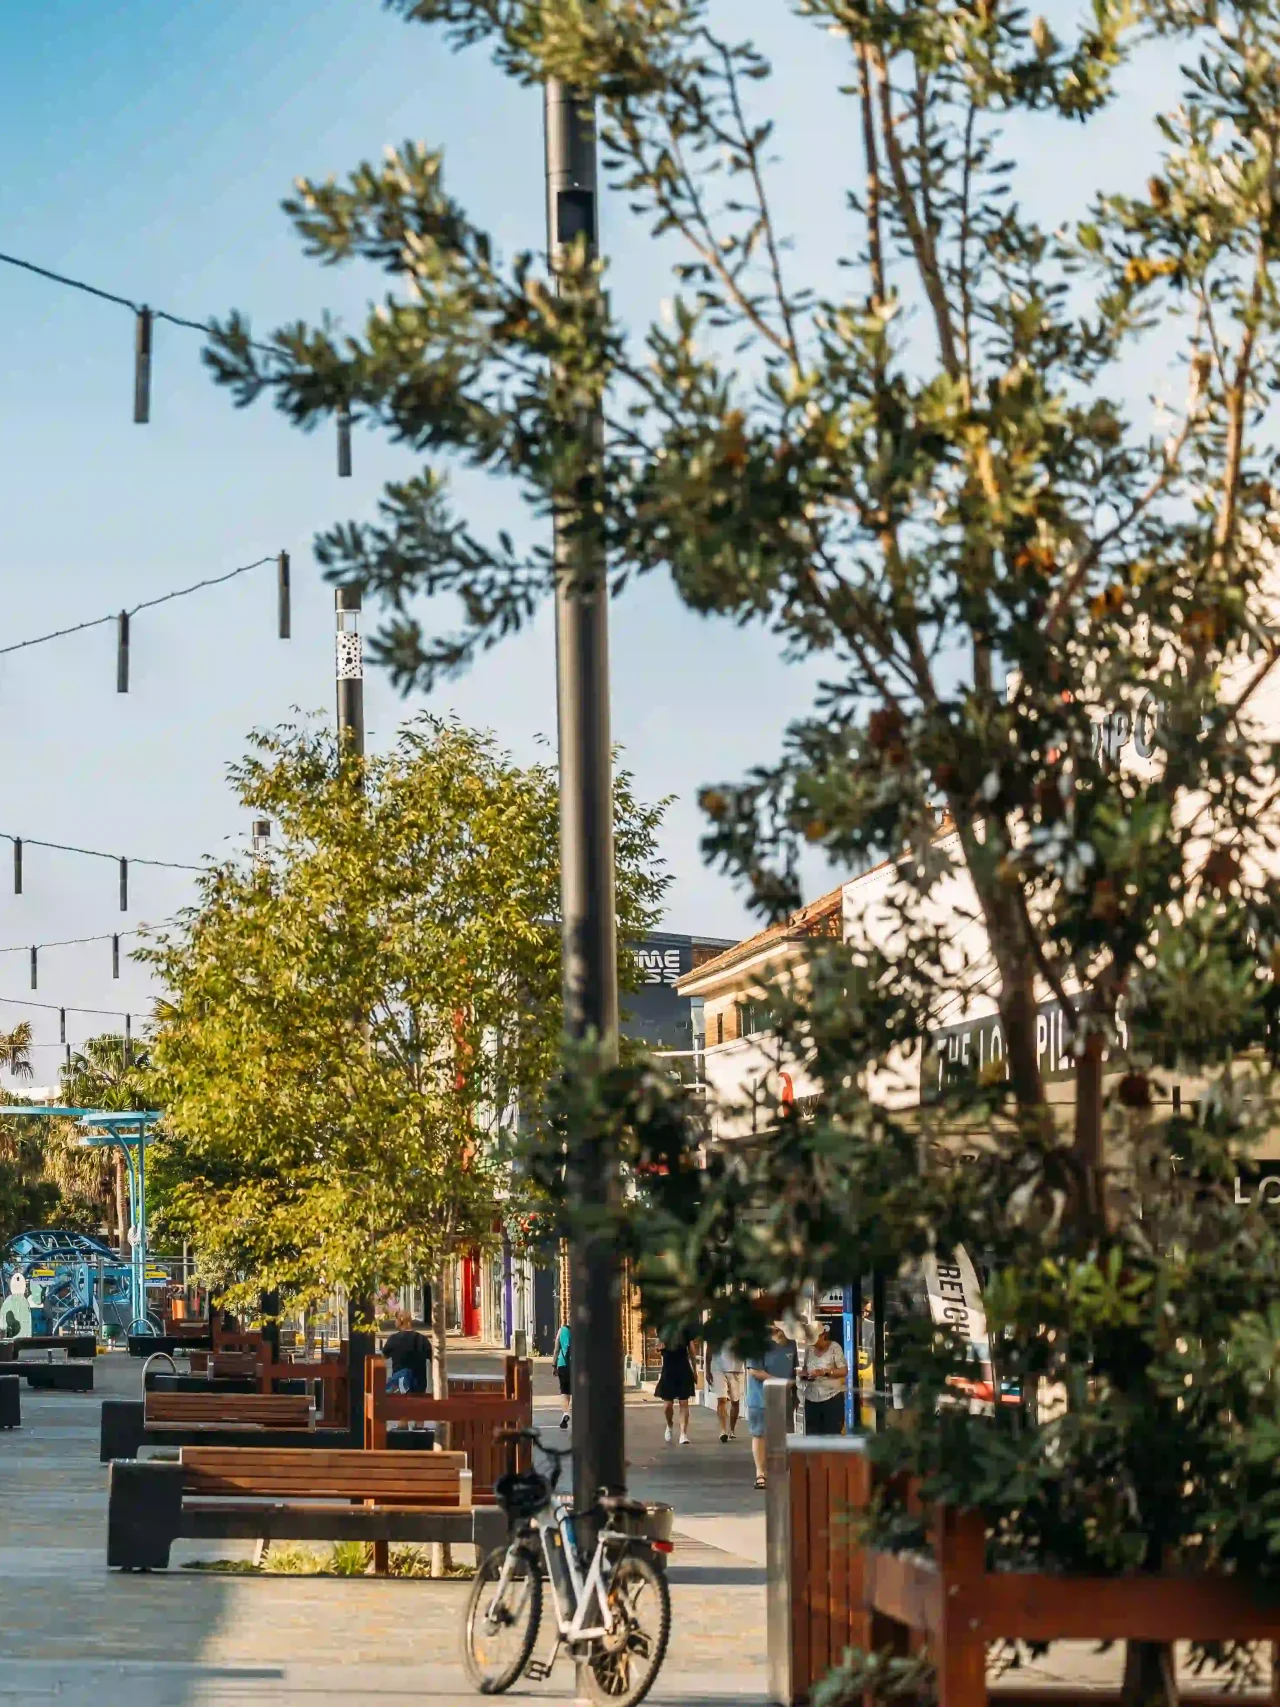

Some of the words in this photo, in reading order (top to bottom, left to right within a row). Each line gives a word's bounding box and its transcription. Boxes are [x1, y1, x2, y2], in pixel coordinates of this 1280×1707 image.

[630, 950, 680, 968] IME
[634, 968, 680, 984] SS
[937, 1263, 971, 1338] RETCH
